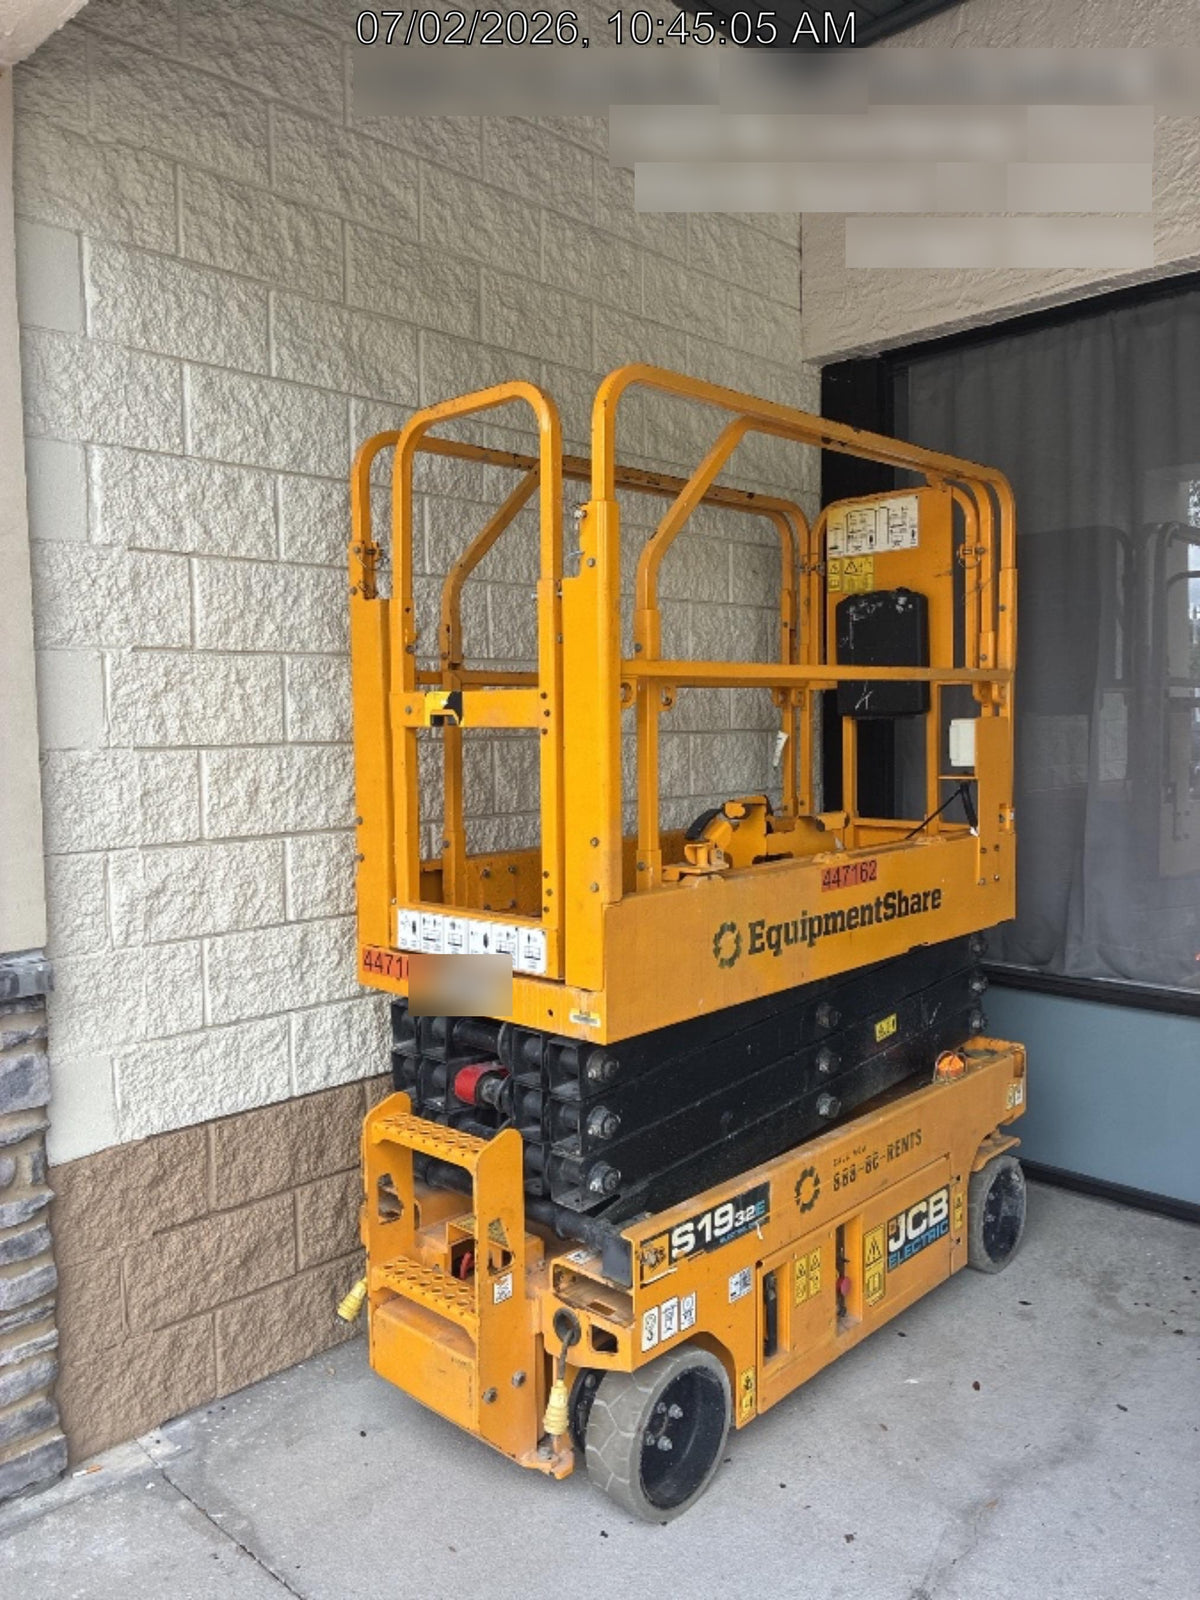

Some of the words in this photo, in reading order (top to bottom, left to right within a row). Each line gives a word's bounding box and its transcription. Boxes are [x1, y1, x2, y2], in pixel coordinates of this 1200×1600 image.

[822, 859, 877, 889] 447162
[747, 887, 942, 957] EquipmentShare
[364, 950, 409, 979] 4471
[888, 1188, 949, 1253] JCB
[889, 1218, 949, 1270] ELECTRIC
